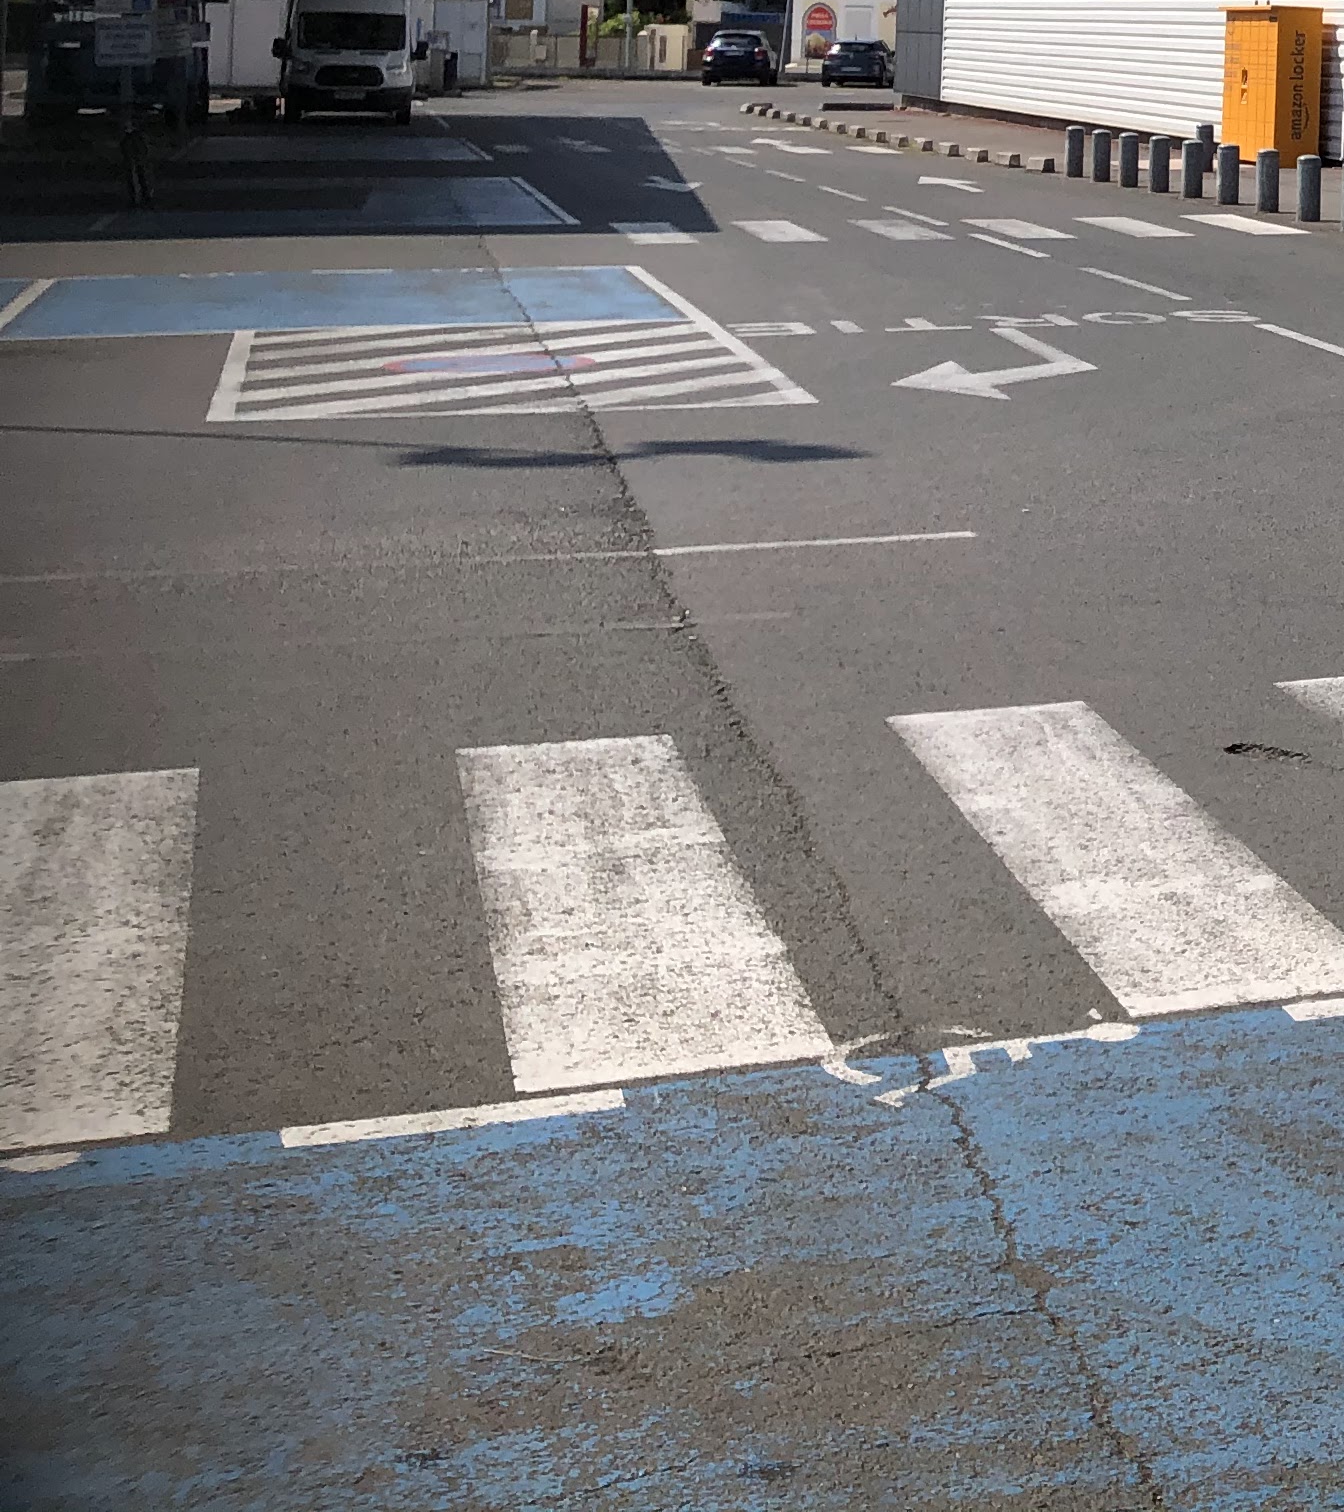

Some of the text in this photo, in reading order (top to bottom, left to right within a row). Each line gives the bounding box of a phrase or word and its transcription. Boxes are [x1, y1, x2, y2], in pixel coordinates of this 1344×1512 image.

[1289, 30, 1309, 141] amazon locker
[726, 309, 1262, 338] SORTIE
